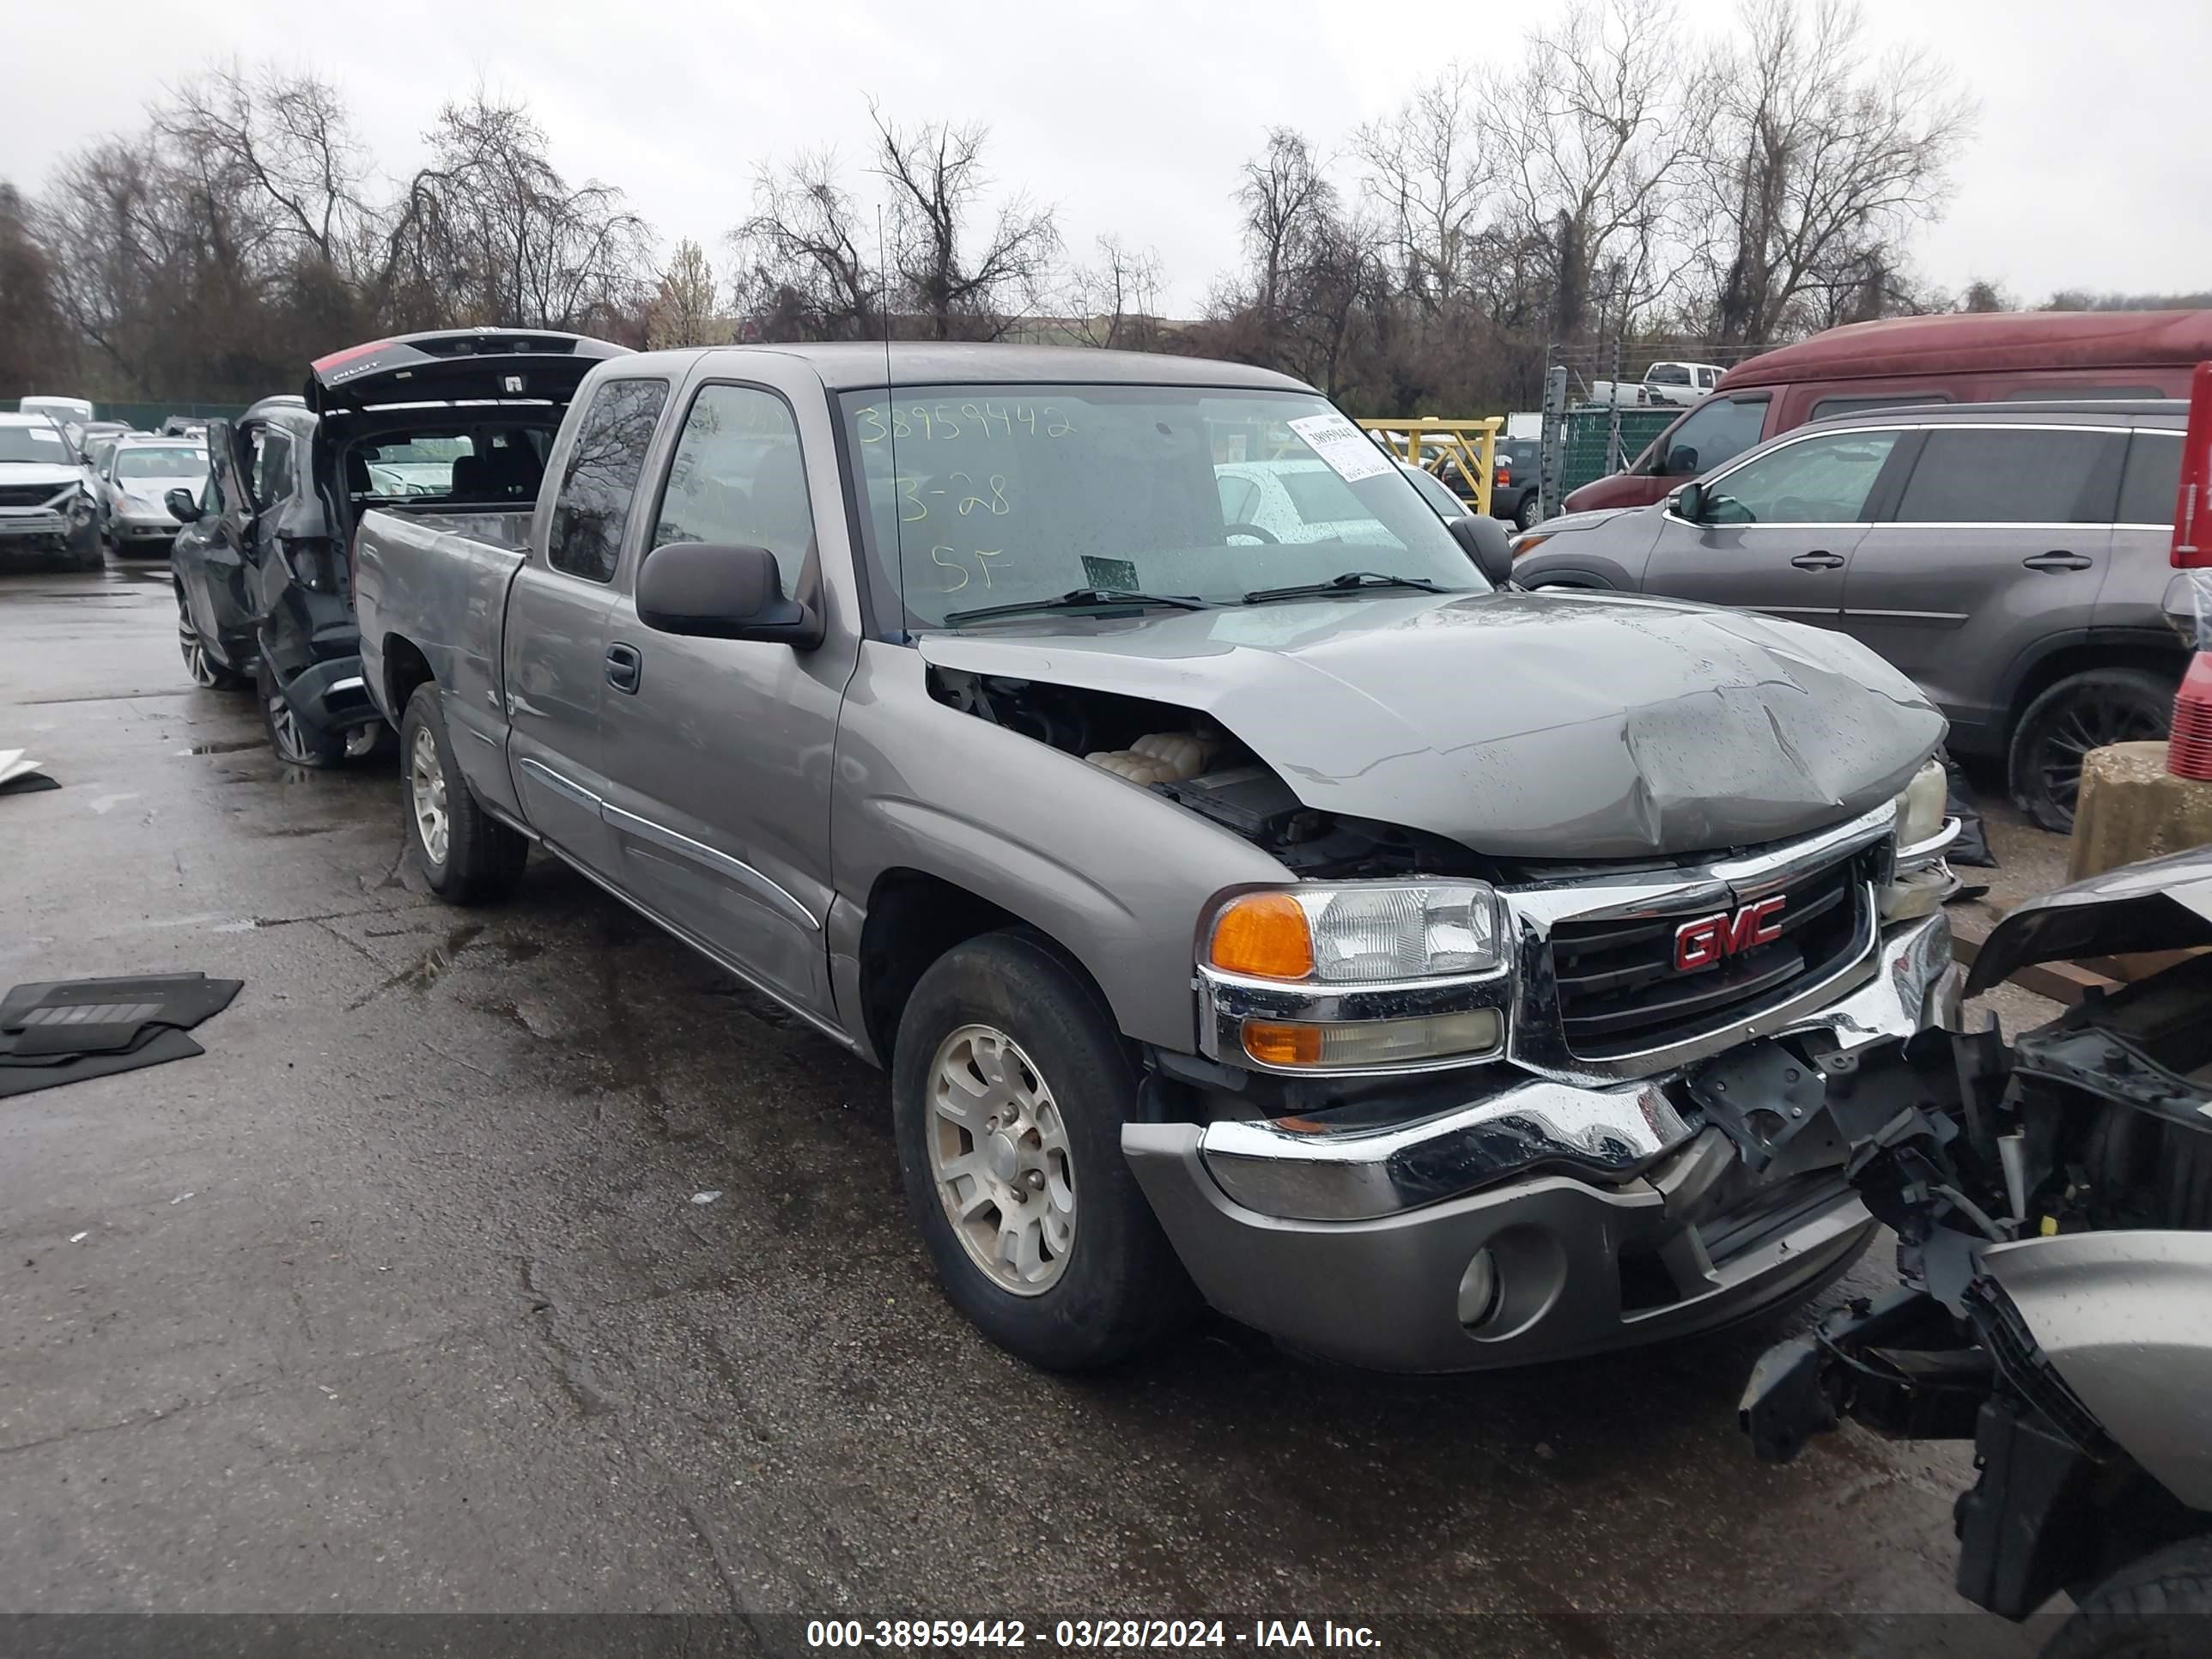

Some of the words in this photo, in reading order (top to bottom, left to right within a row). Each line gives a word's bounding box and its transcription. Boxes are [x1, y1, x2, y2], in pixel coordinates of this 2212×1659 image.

[332, 361, 382, 382] PILOT
[854, 402, 1078, 443] 38959442
[1308, 427, 1358, 446] 38959442
[889, 472, 1009, 522] 3-28
[1674, 894, 1787, 971] GMC
